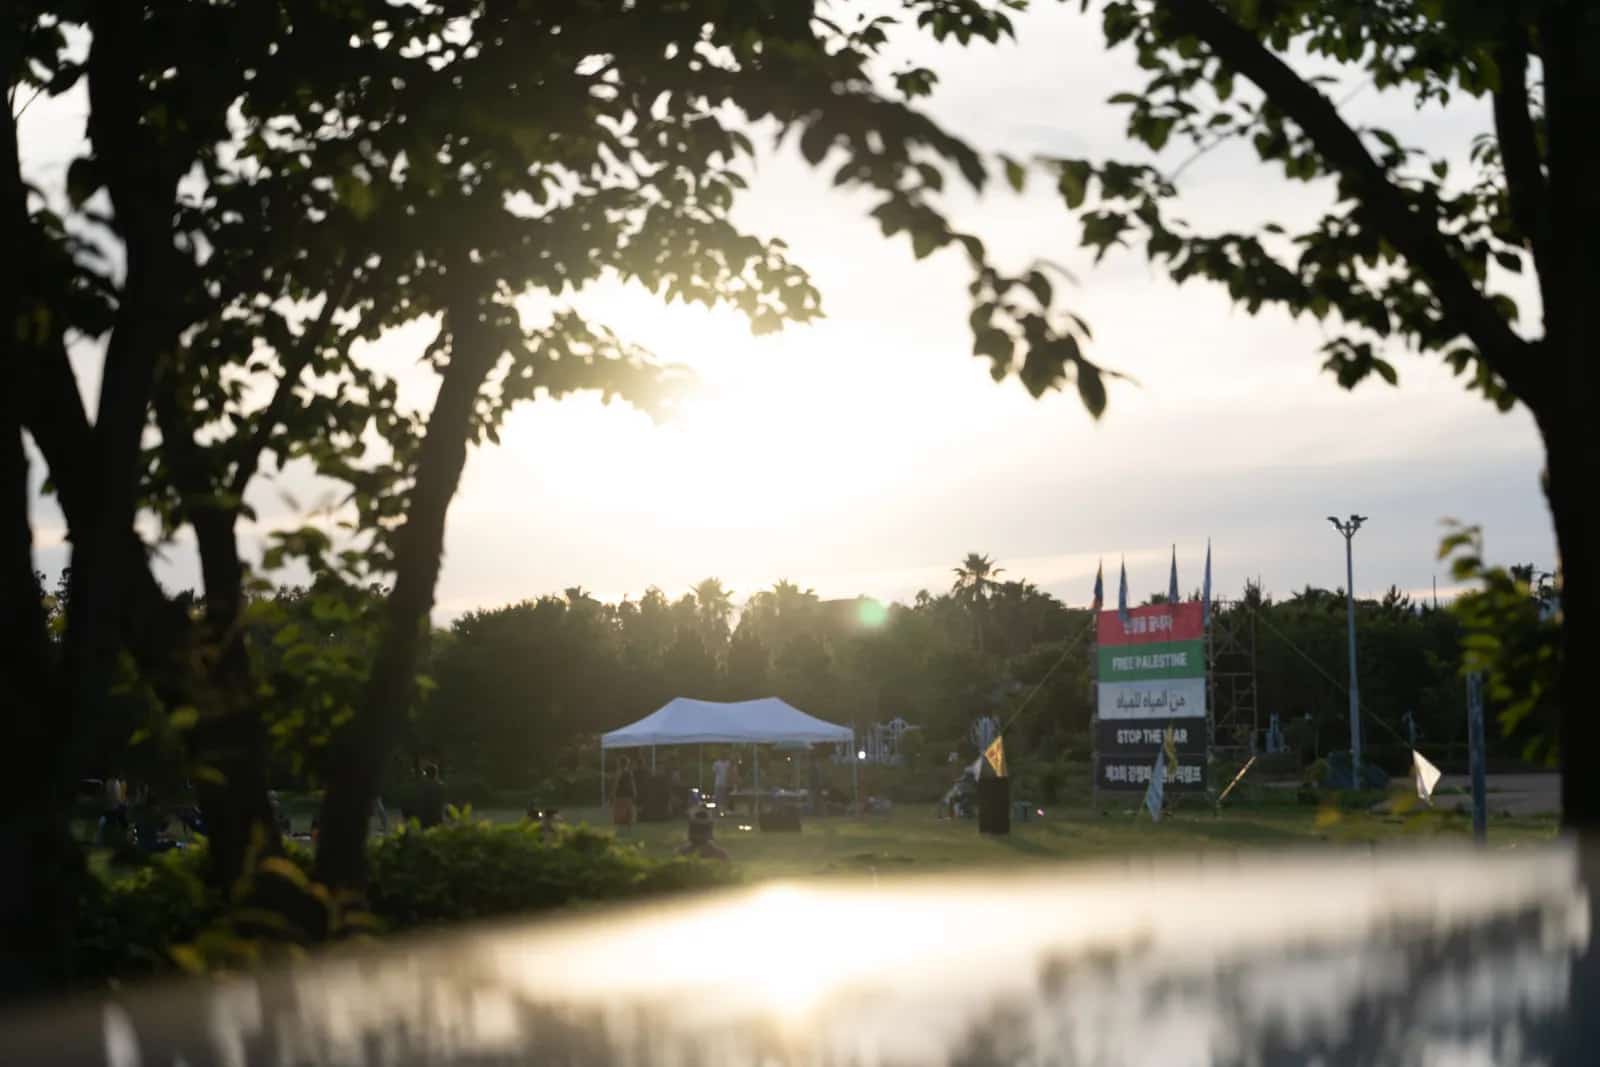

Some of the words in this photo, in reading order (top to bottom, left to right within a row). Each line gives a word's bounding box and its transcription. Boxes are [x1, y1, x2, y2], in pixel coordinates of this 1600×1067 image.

[1112, 656, 1134, 672] FREE
[1136, 652, 1187, 670] PALESTINE
[1117, 729, 1142, 744] STOP
[1143, 729, 1162, 743] THE
